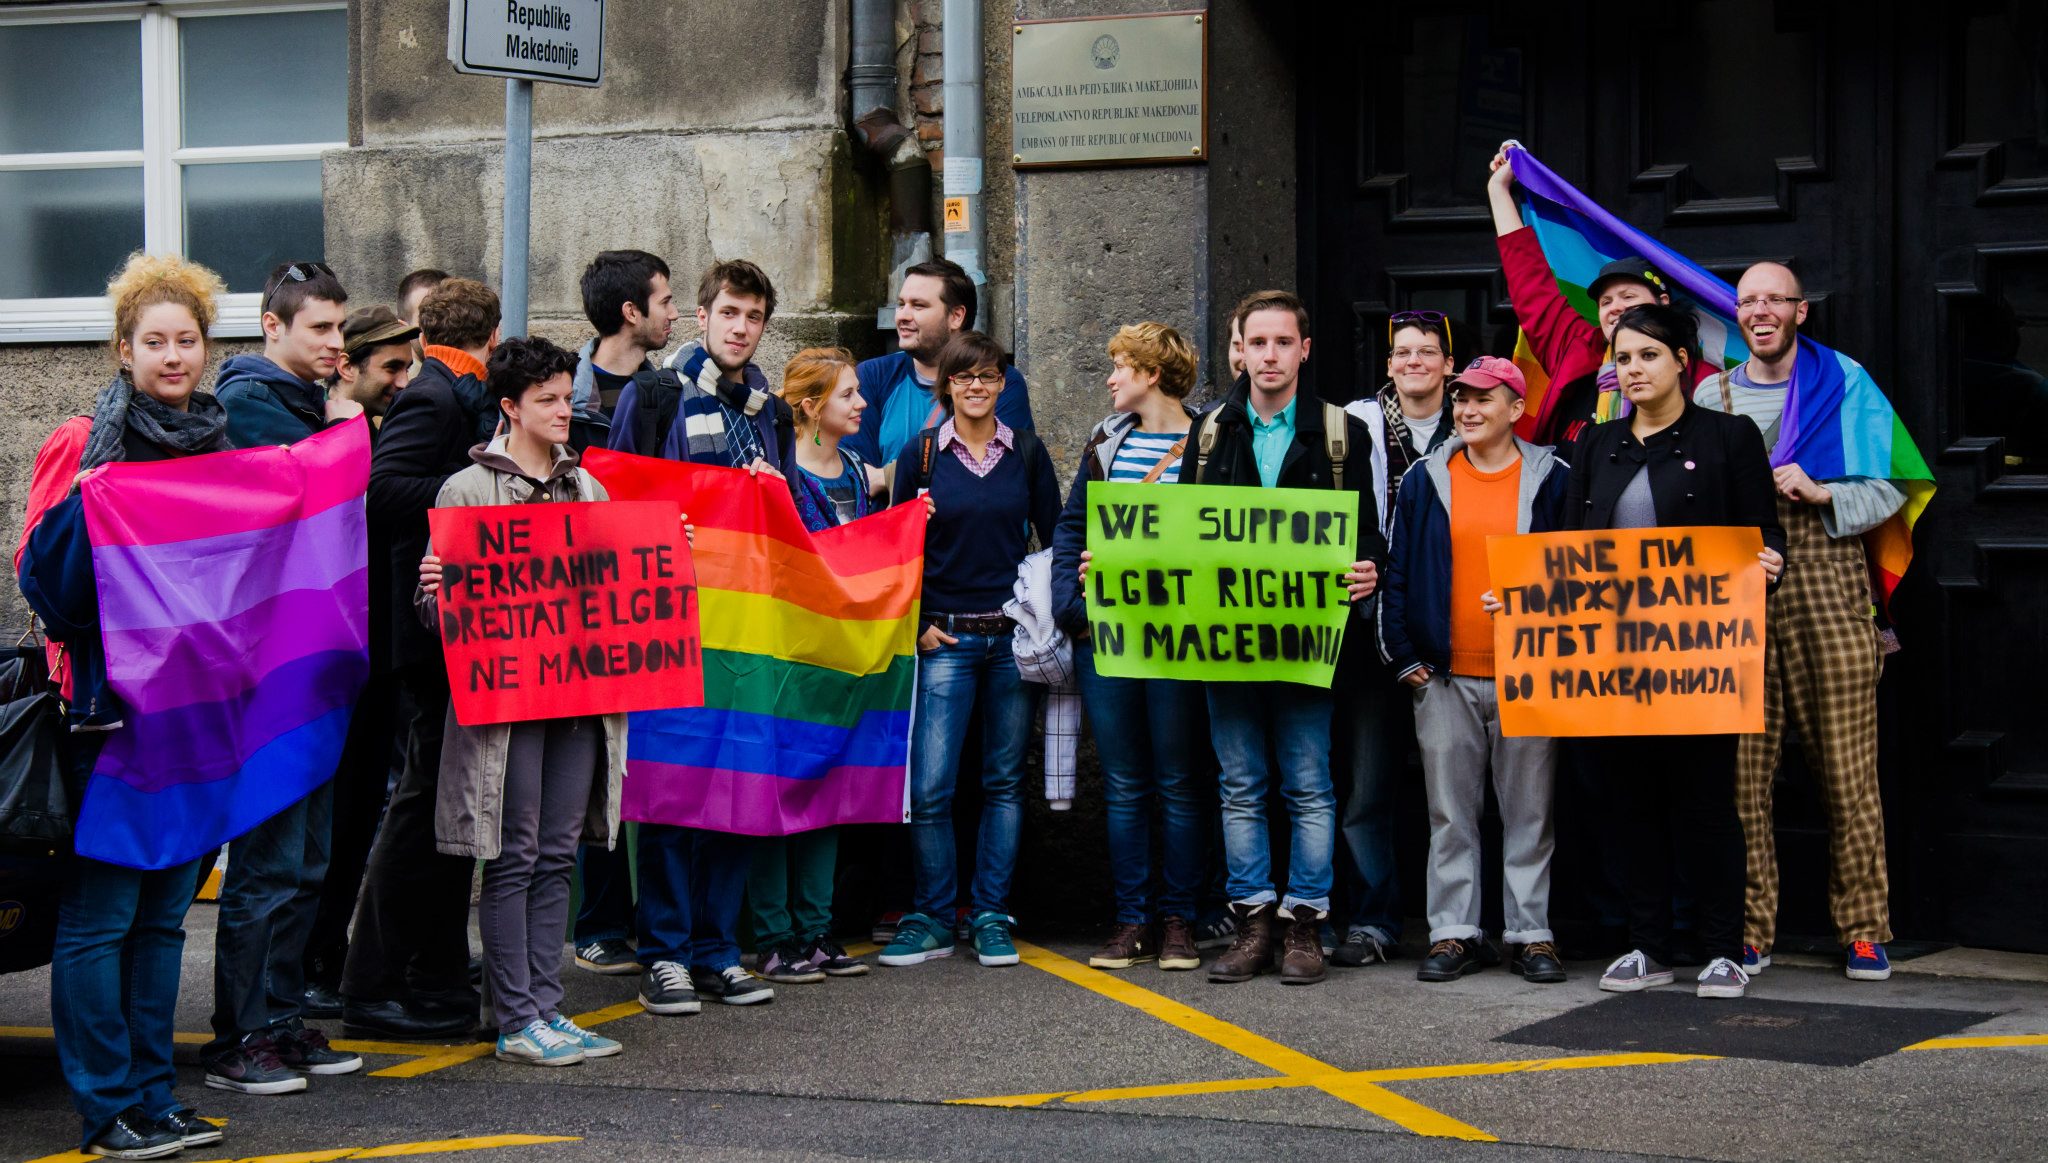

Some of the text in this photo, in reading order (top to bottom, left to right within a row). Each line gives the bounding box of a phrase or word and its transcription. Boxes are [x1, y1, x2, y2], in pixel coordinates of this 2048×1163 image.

[507, 0, 570, 31] Republike
[506, 34, 579, 70] Makedonije
[1016, 78, 1199, 98] АМБАСАДА НА РЕПУБЛИКА МАКЕДОНИЈА
[1015, 103, 1199, 123] VELEPOSLANSTVO REPUBLIKE MAKEDONIJE
[1021, 130, 1193, 149] EMBASSY OF THE REPUBLIC OF MACEDONIA
[478, 514, 574, 557] NE I
[1097, 503, 1350, 546] WE SUPPORT
[442, 545, 675, 603] PERKRAHIM TE
[1095, 567, 1351, 608] LGBT RIGHTS
[443, 585, 698, 646] DREJTAT E LGBT
[1088, 620, 1125, 656] IN
[1513, 623, 1602, 659] ЛГБТ
[470, 637, 698, 692] NE MAQEDONI
[1504, 667, 1737, 705] ВО МАКЕДОНИЈА
